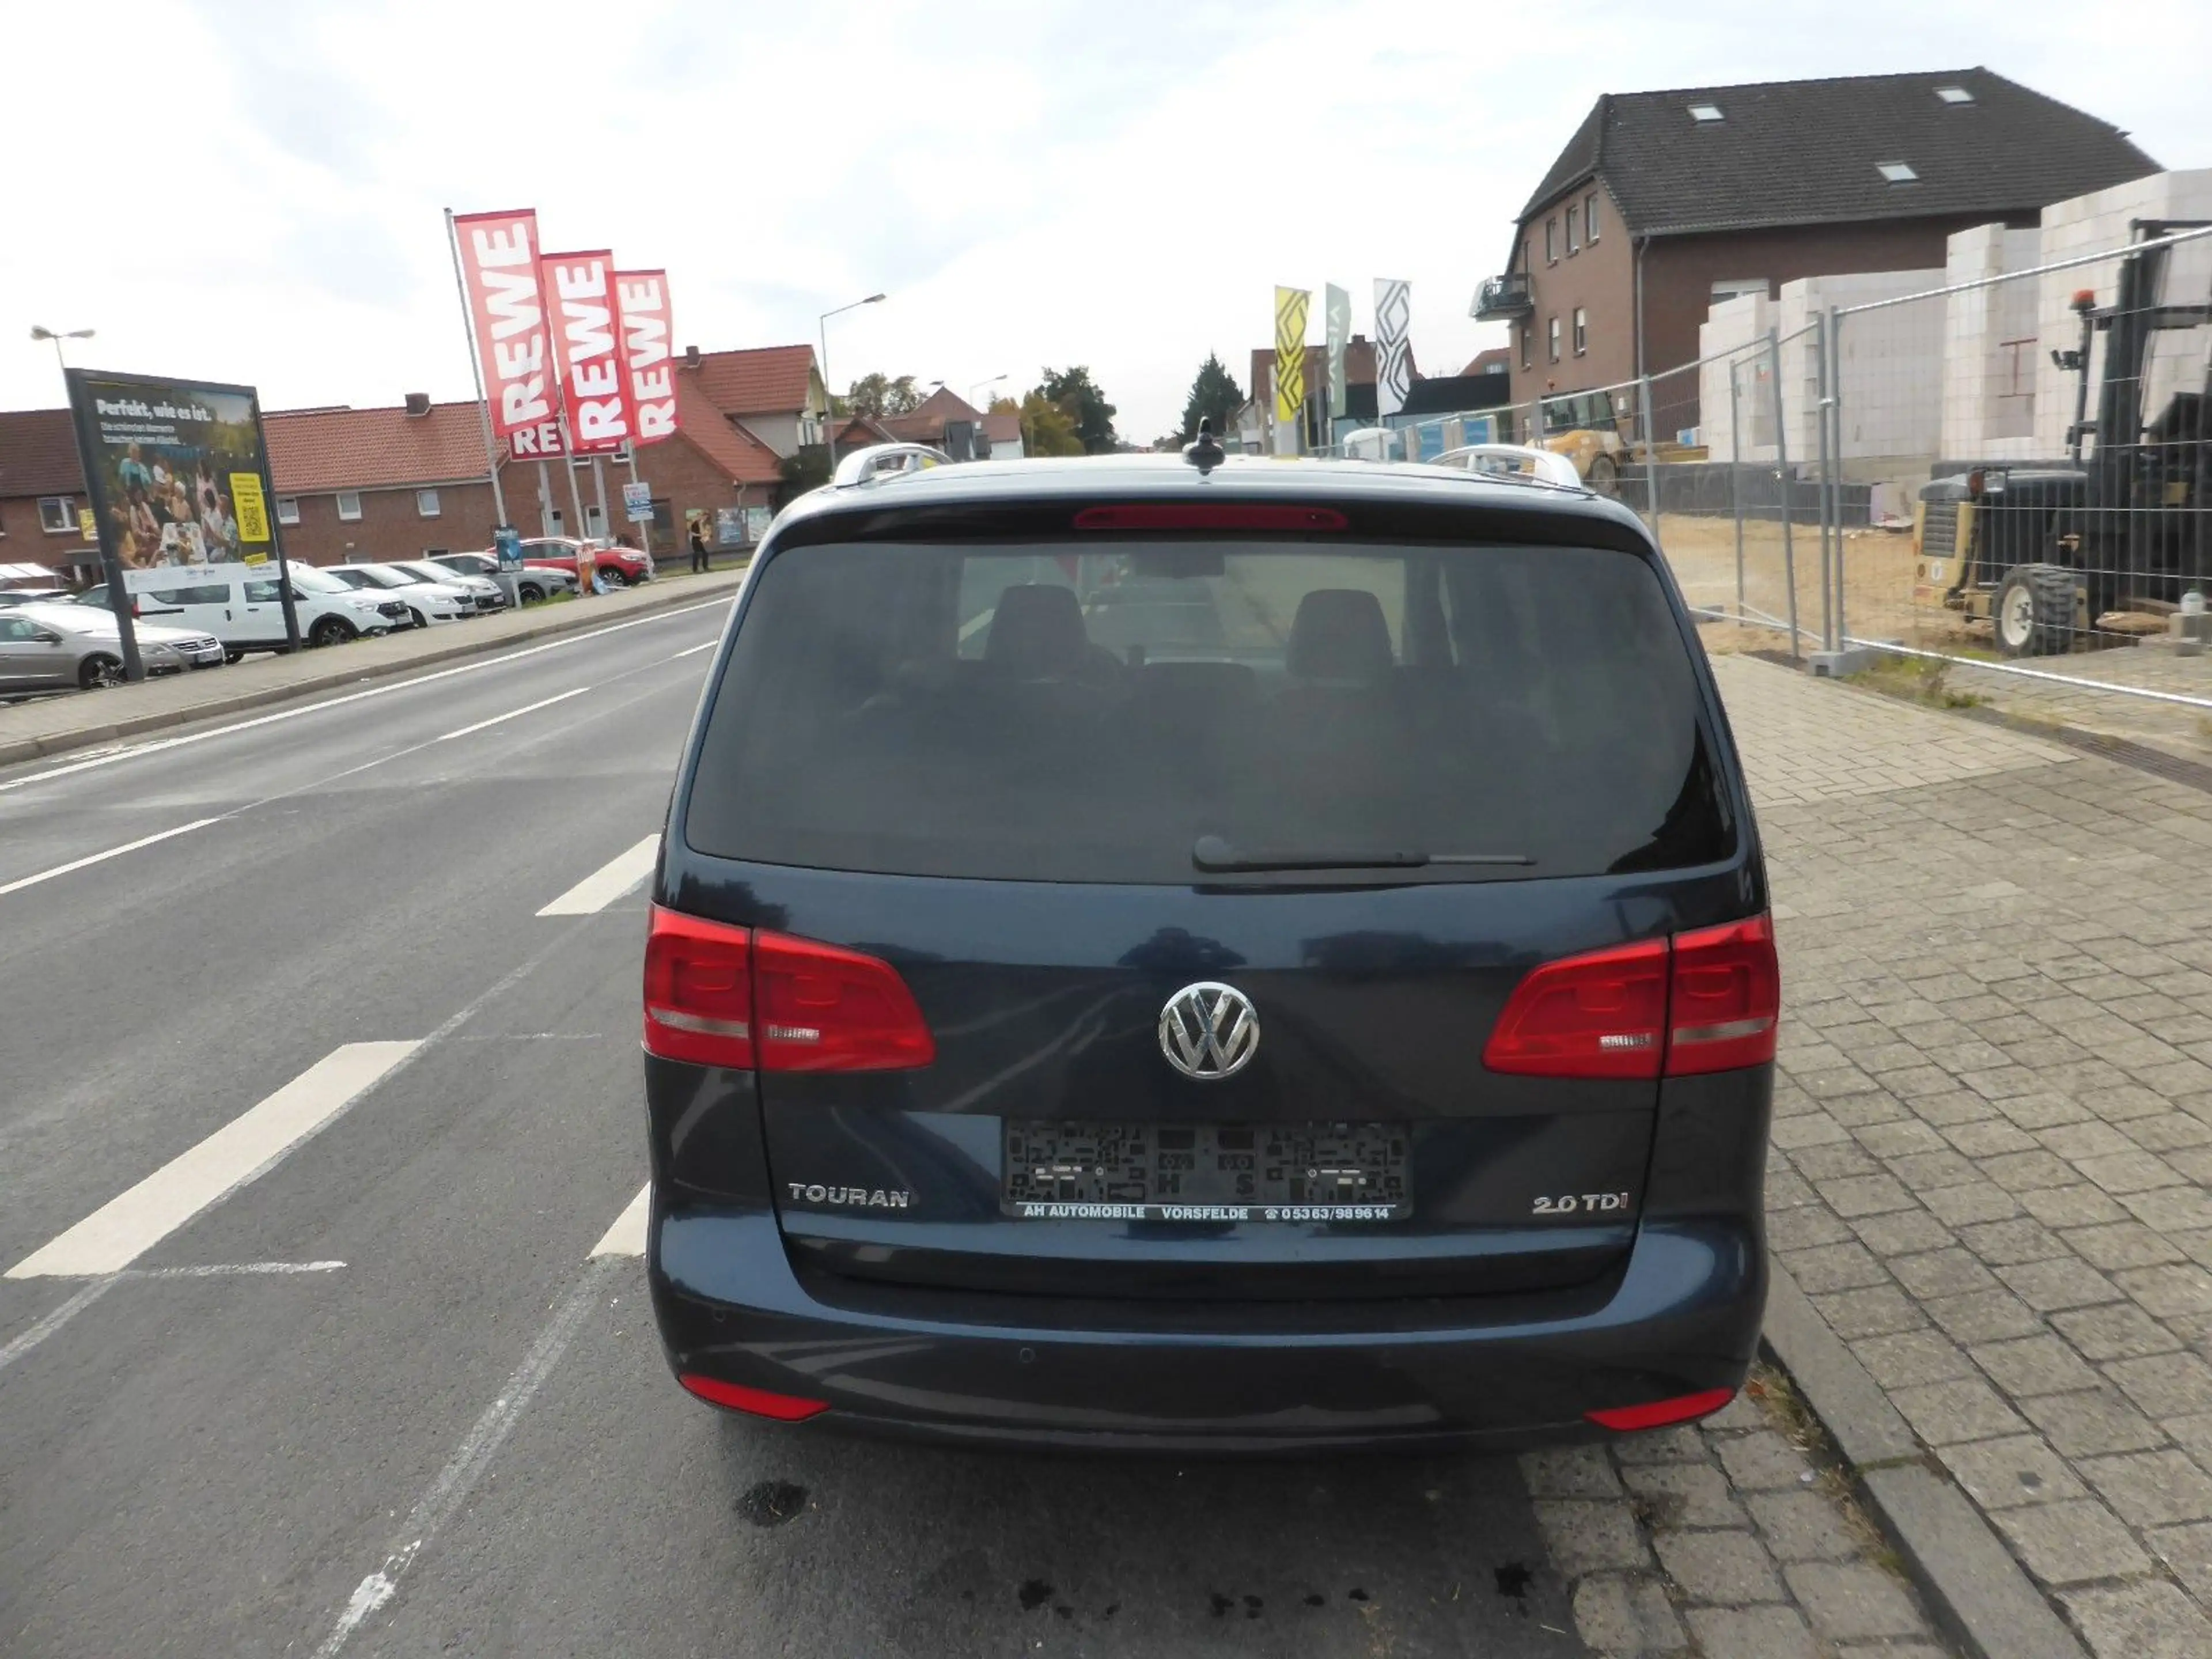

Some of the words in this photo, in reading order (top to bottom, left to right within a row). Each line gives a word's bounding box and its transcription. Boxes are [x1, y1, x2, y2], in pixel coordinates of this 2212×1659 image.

[472, 222, 550, 425] REWE
[555, 261, 627, 440] REWE
[618, 279, 676, 438] REWE
[153, 401, 176, 418] wie
[177, 408, 191, 419] es
[788, 1183, 909, 1208] TOURAN
[1532, 1195, 1577, 1214] 2.0
[1581, 1192, 1628, 1211] TDI
[1024, 1205, 1044, 1217] AH
[1049, 1205, 1145, 1218] AUTOMOBILE
[1162, 1207, 1248, 1219] VORSFELDE
